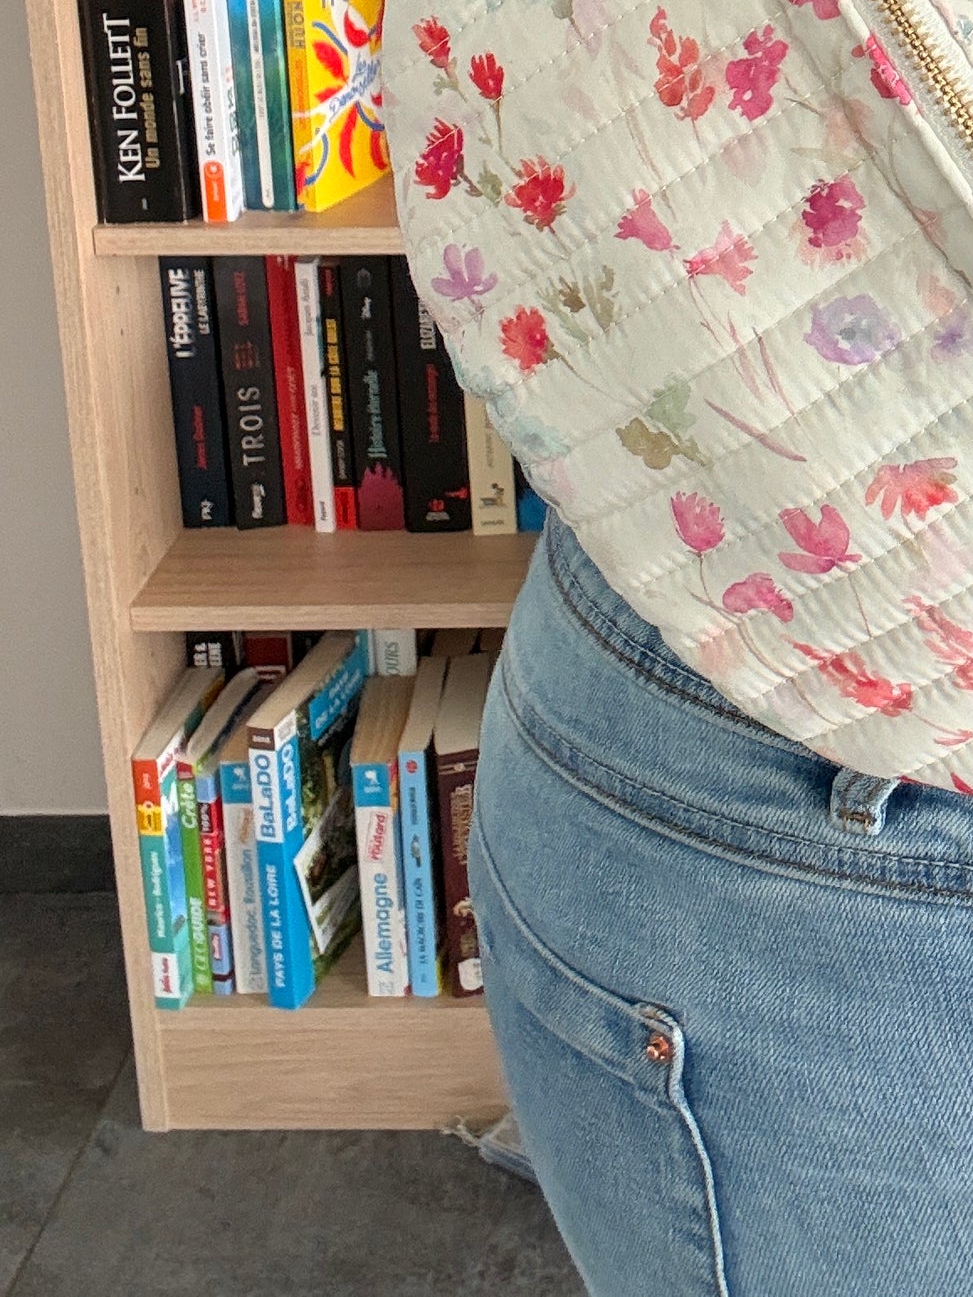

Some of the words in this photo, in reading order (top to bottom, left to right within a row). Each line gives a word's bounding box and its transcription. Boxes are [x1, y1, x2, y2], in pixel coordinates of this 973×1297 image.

[132, 27, 149, 48] fin
[293, 1, 306, 49] HUON
[102, 12, 139, 120] FOLLETT
[137, 51, 154, 89] sans
[139, 92, 158, 143] monde
[117, 129, 146, 183] KEN
[144, 147, 161, 169] Un
[237, 386, 265, 466] TROIS
[254, 751, 277, 839] BaLaDO
[265, 863, 280, 907] LOIRE
[269, 908, 282, 928] LA
[271, 929, 283, 950] DE
[373, 873, 394, 974] Allemagne
[272, 951, 286, 988] PAYS
